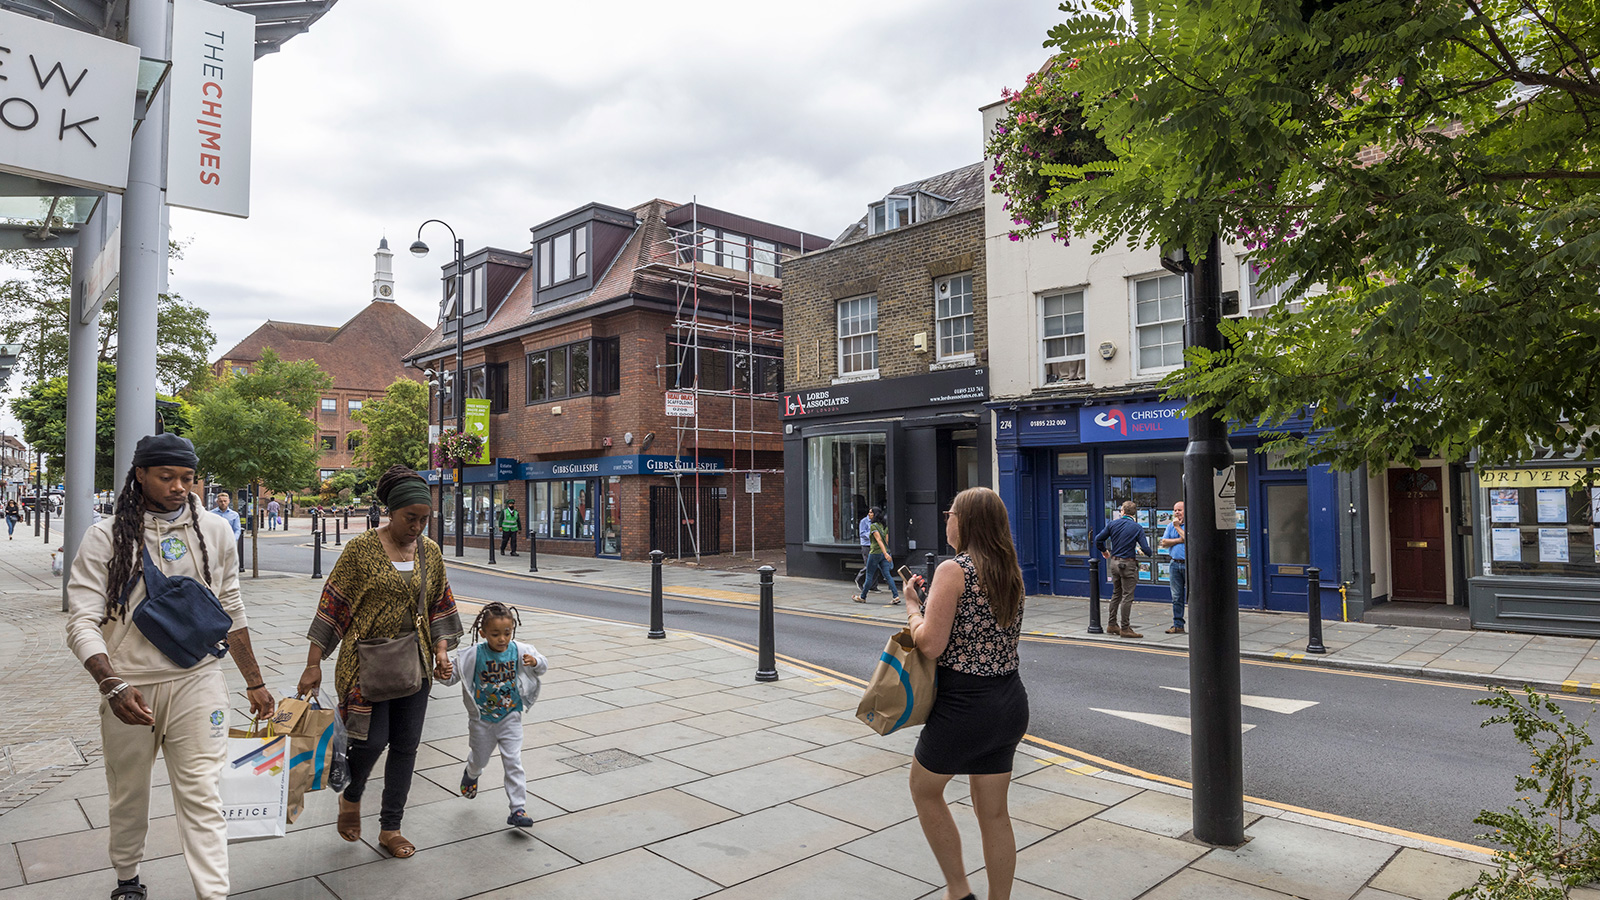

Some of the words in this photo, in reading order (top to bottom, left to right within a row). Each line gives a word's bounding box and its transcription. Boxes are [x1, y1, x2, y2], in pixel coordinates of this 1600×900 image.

[806, 391, 829, 401] LORDS
[806, 397, 849, 408] ASSOCIATES
[1131, 408, 1188, 420] CHRISTOP
[1000, 420, 1012, 430] 274
[1132, 422, 1164, 431] NEVILL
[1481, 470, 1583, 483] DRIVERS
[485, 660, 515, 673] TUNE
[480, 670, 516, 684] SQUAD
